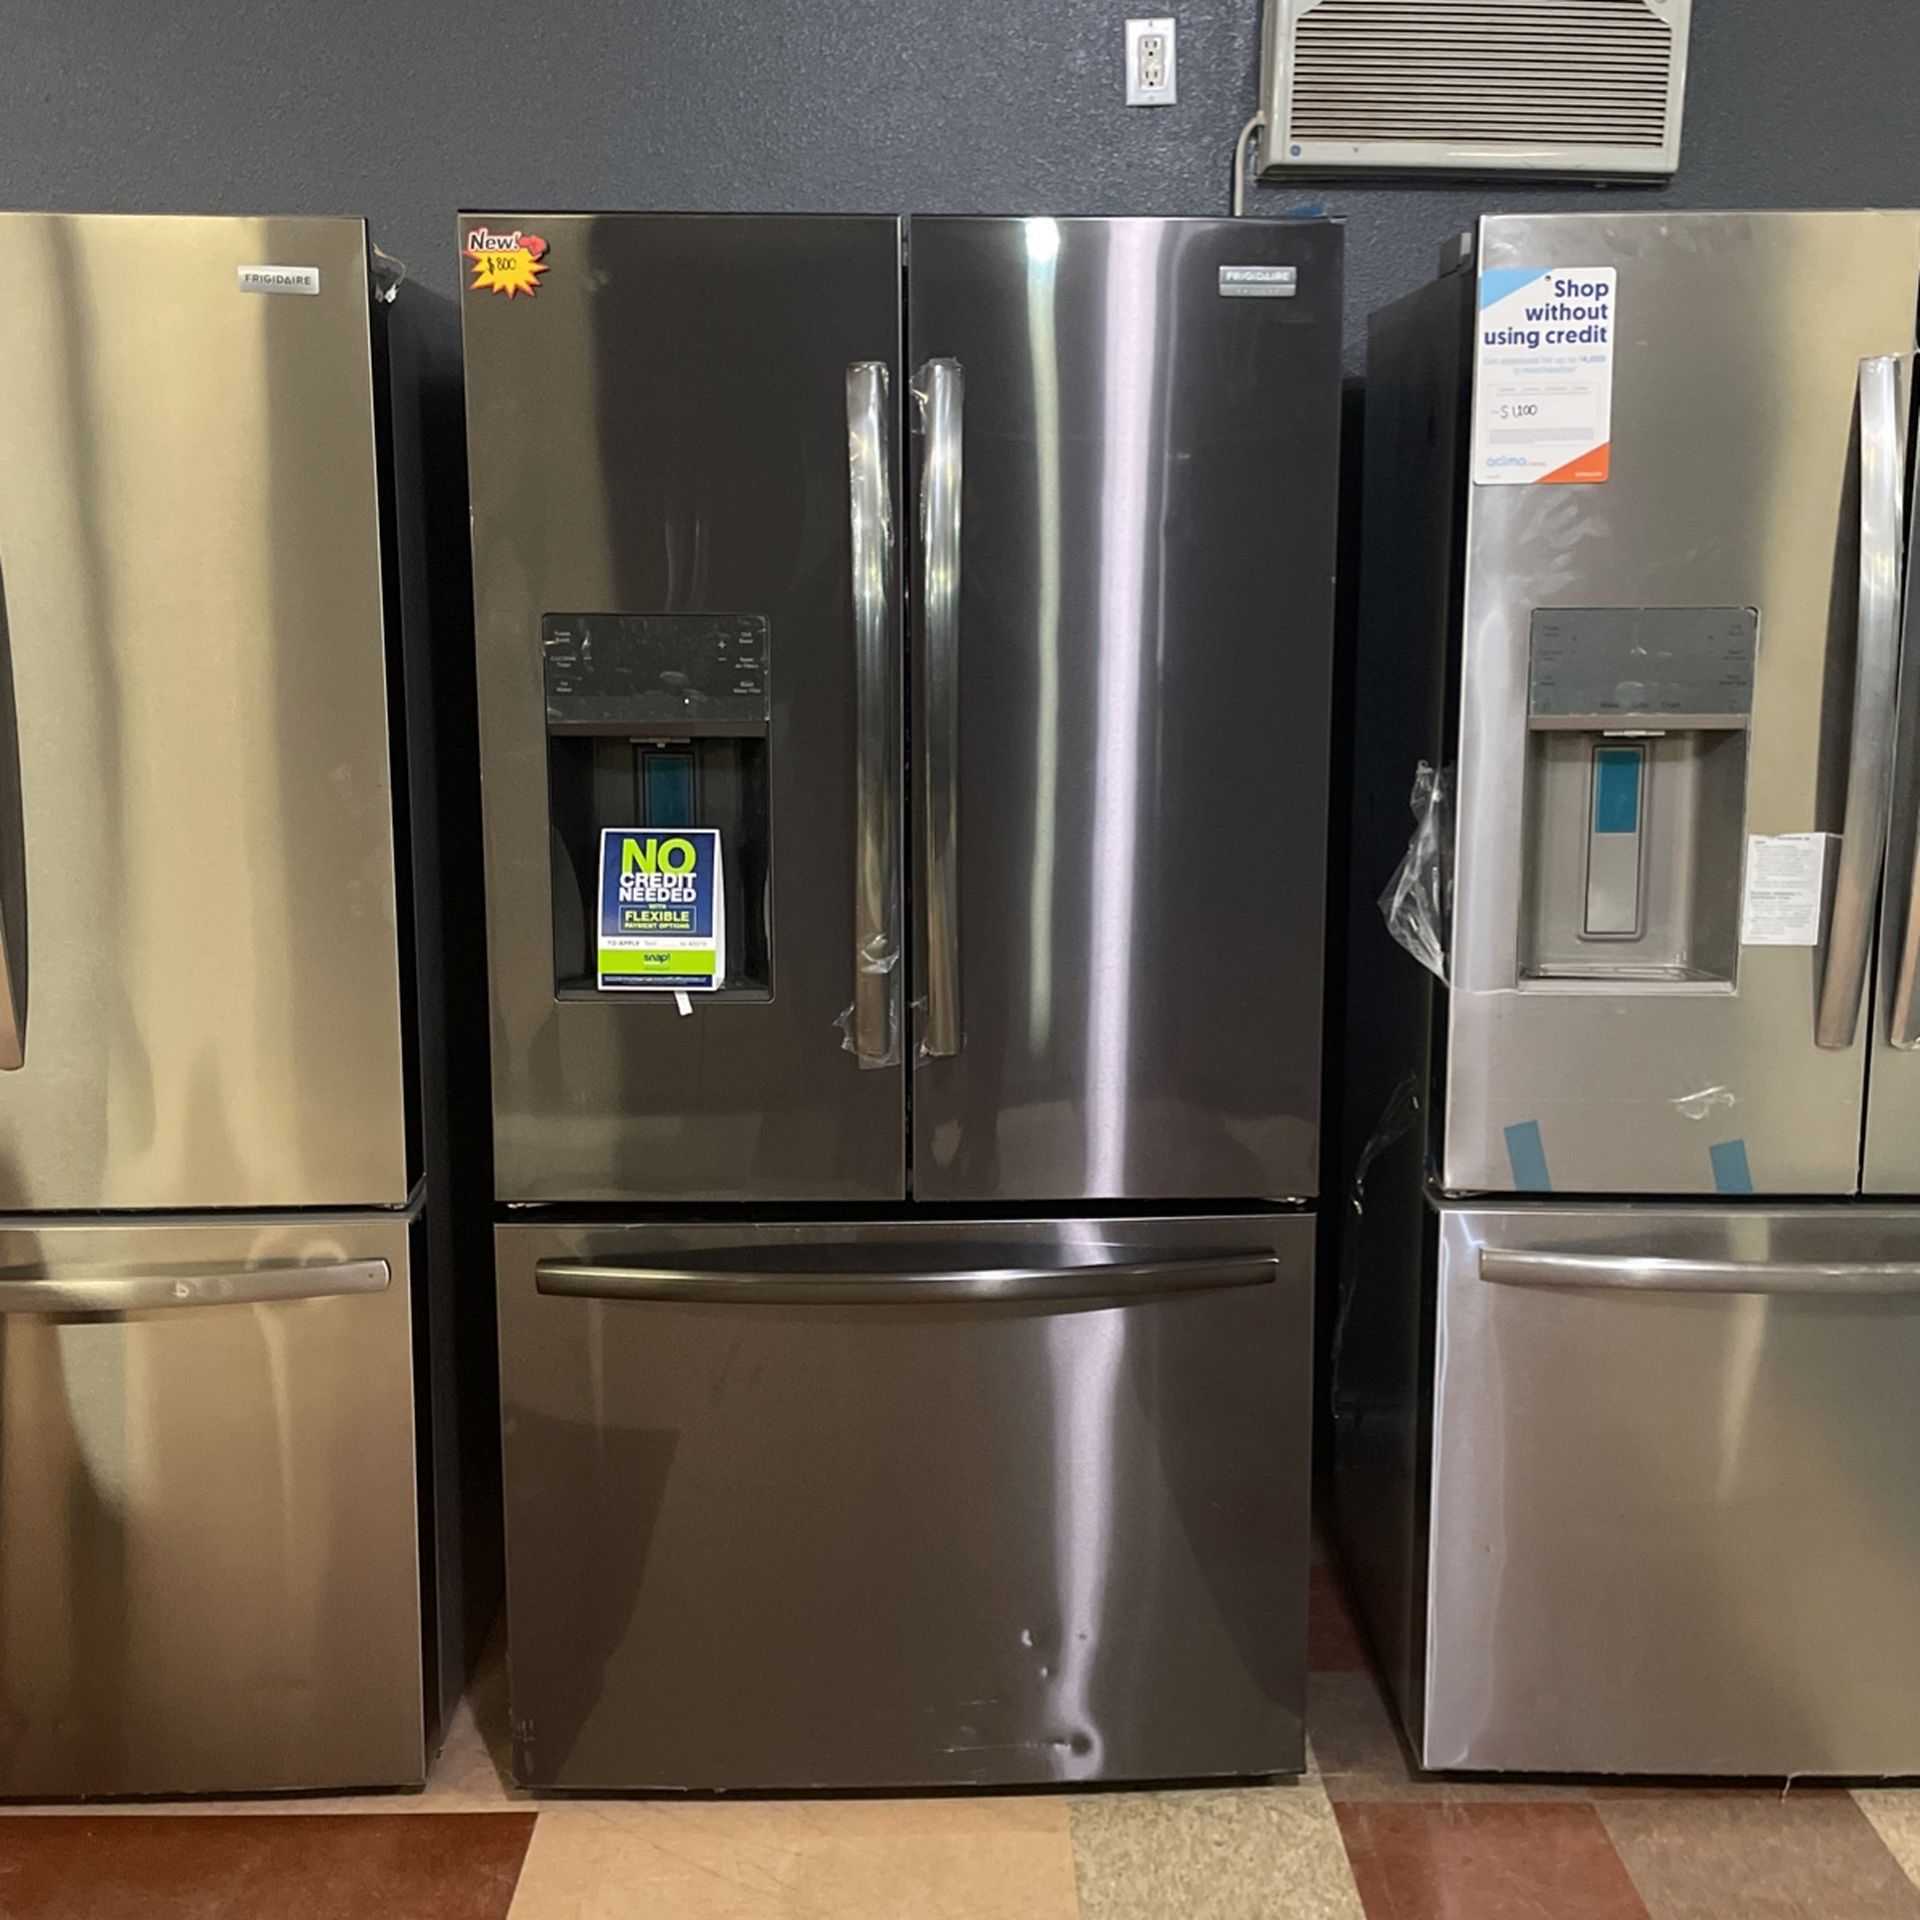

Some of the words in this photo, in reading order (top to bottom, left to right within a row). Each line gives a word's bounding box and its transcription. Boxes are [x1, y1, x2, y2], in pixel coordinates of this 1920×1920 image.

[470, 231, 520, 250] New!
[244, 274, 312, 285] FRIGIDAIRE
[1554, 279, 1609, 301] Shop
[1525, 303, 1608, 321] without
[1484, 326, 1540, 349] using
[1545, 325, 1607, 344] credit
[621, 838, 697, 874] NO
[619, 872, 697, 888] CREDIT
[619, 887, 697, 902] NEEDED
[625, 911, 690, 922] FLEXIBLE
